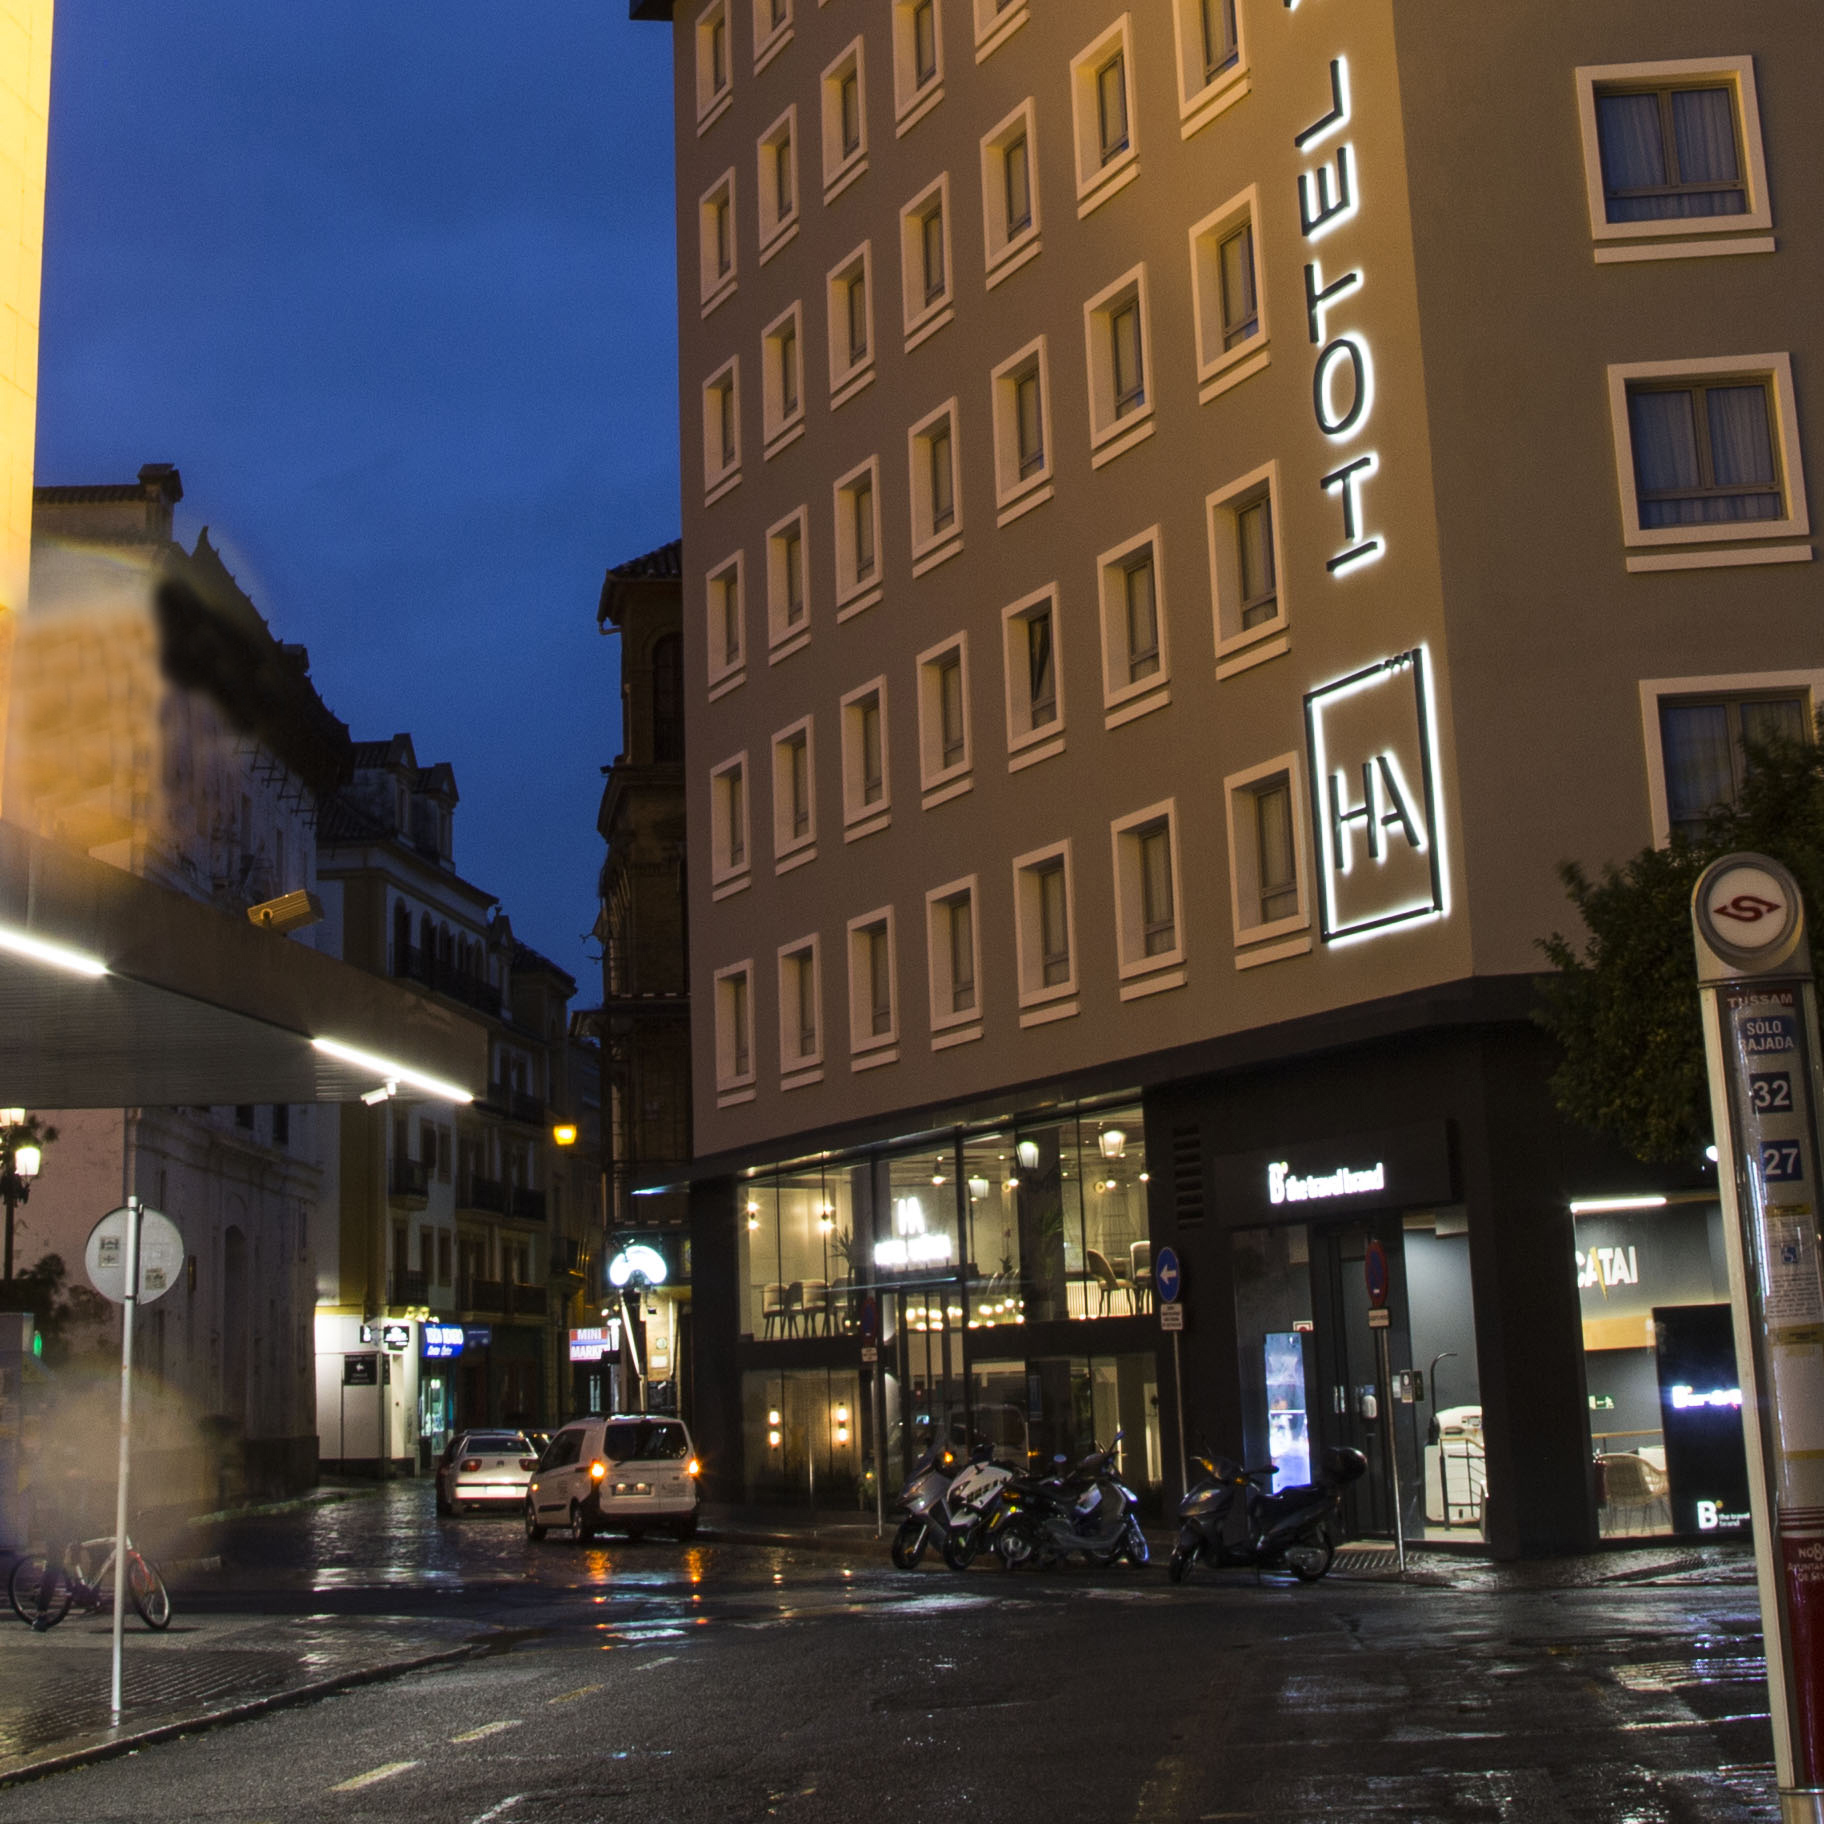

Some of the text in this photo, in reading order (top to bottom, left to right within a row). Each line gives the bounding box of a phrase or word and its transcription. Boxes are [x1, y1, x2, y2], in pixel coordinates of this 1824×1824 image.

[1294, 55, 1386, 578] HOTEL
[1328, 749, 1426, 874] HA
[1727, 992, 1794, 1009] TUSSAM
[1746, 1018, 1783, 1035] SÓLO
[1739, 1035, 1795, 1052] BAJADA
[1752, 1079, 1791, 1108] 32
[1763, 1147, 1799, 1175] 27
[577, 1328, 602, 1341] MINI
[1696, 1500, 1719, 1530] B
